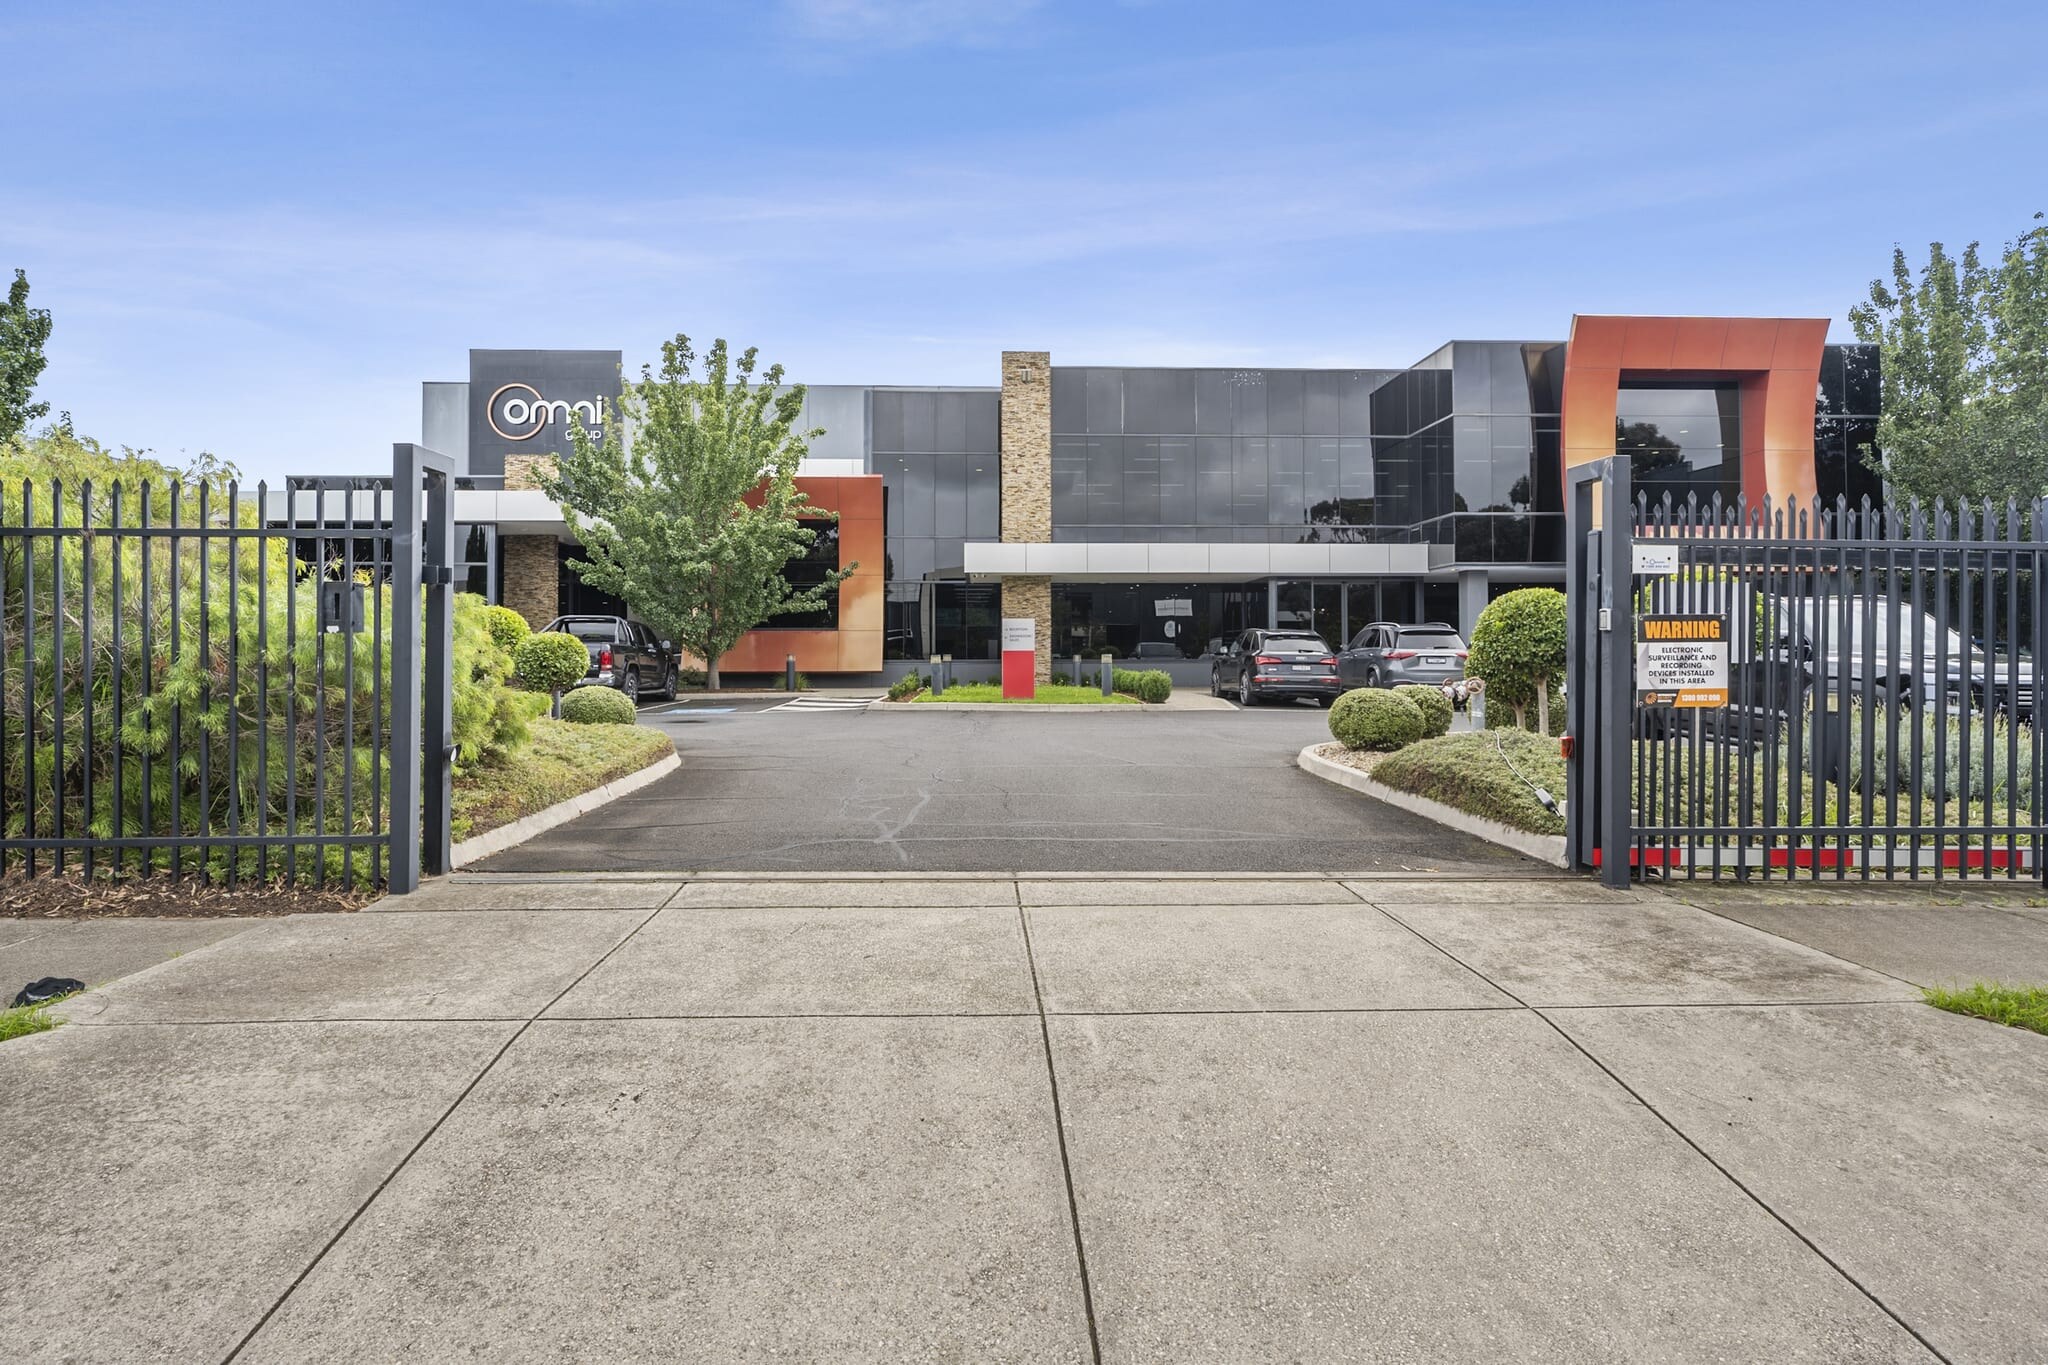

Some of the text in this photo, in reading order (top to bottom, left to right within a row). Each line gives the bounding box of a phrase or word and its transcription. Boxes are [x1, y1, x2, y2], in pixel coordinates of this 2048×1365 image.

[503, 394, 602, 425] omni
[565, 430, 602, 441] gup
[1644, 620, 1720, 639] WARNING
